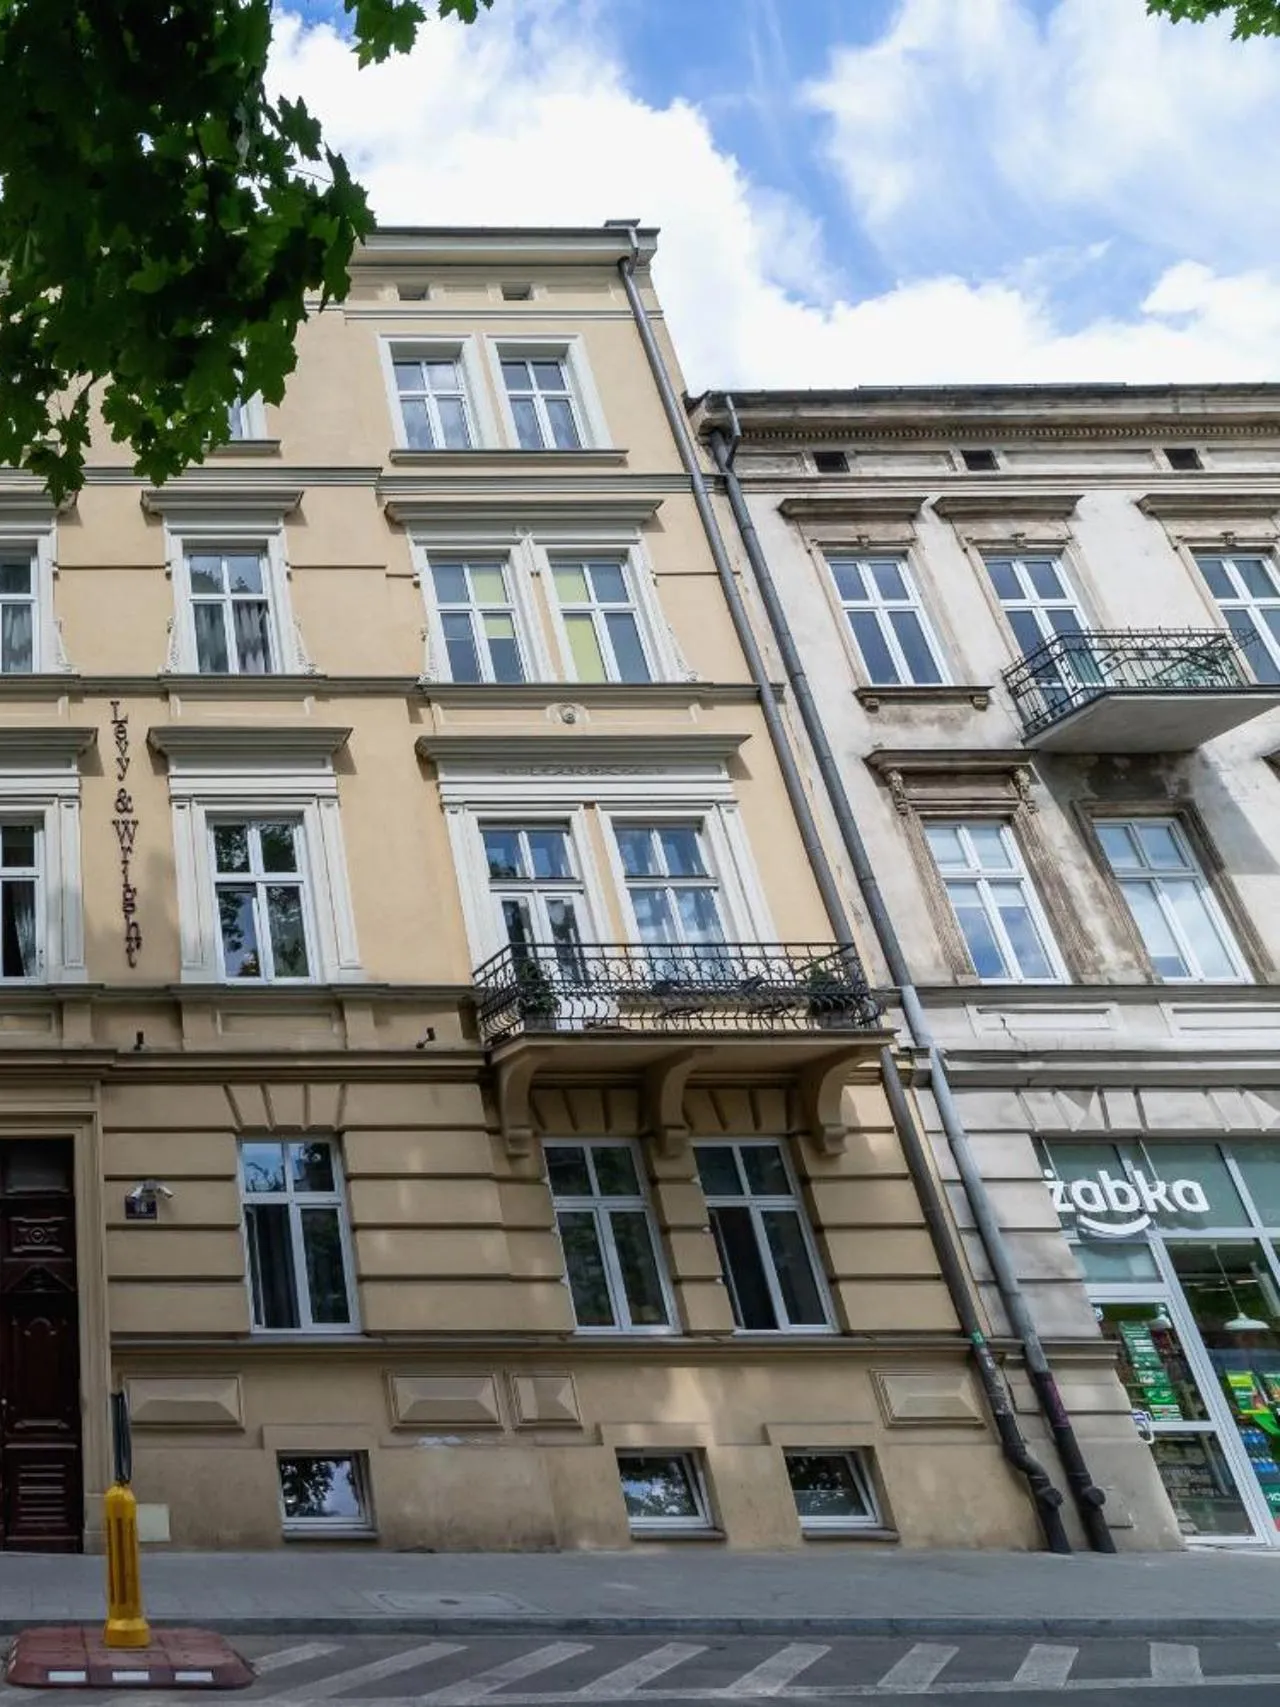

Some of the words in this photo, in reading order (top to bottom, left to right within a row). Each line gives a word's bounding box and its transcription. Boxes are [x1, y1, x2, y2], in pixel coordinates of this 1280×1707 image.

[110, 701, 131, 781] Levy
[114, 788, 134, 814] &
[111, 820, 142, 968] Wright
